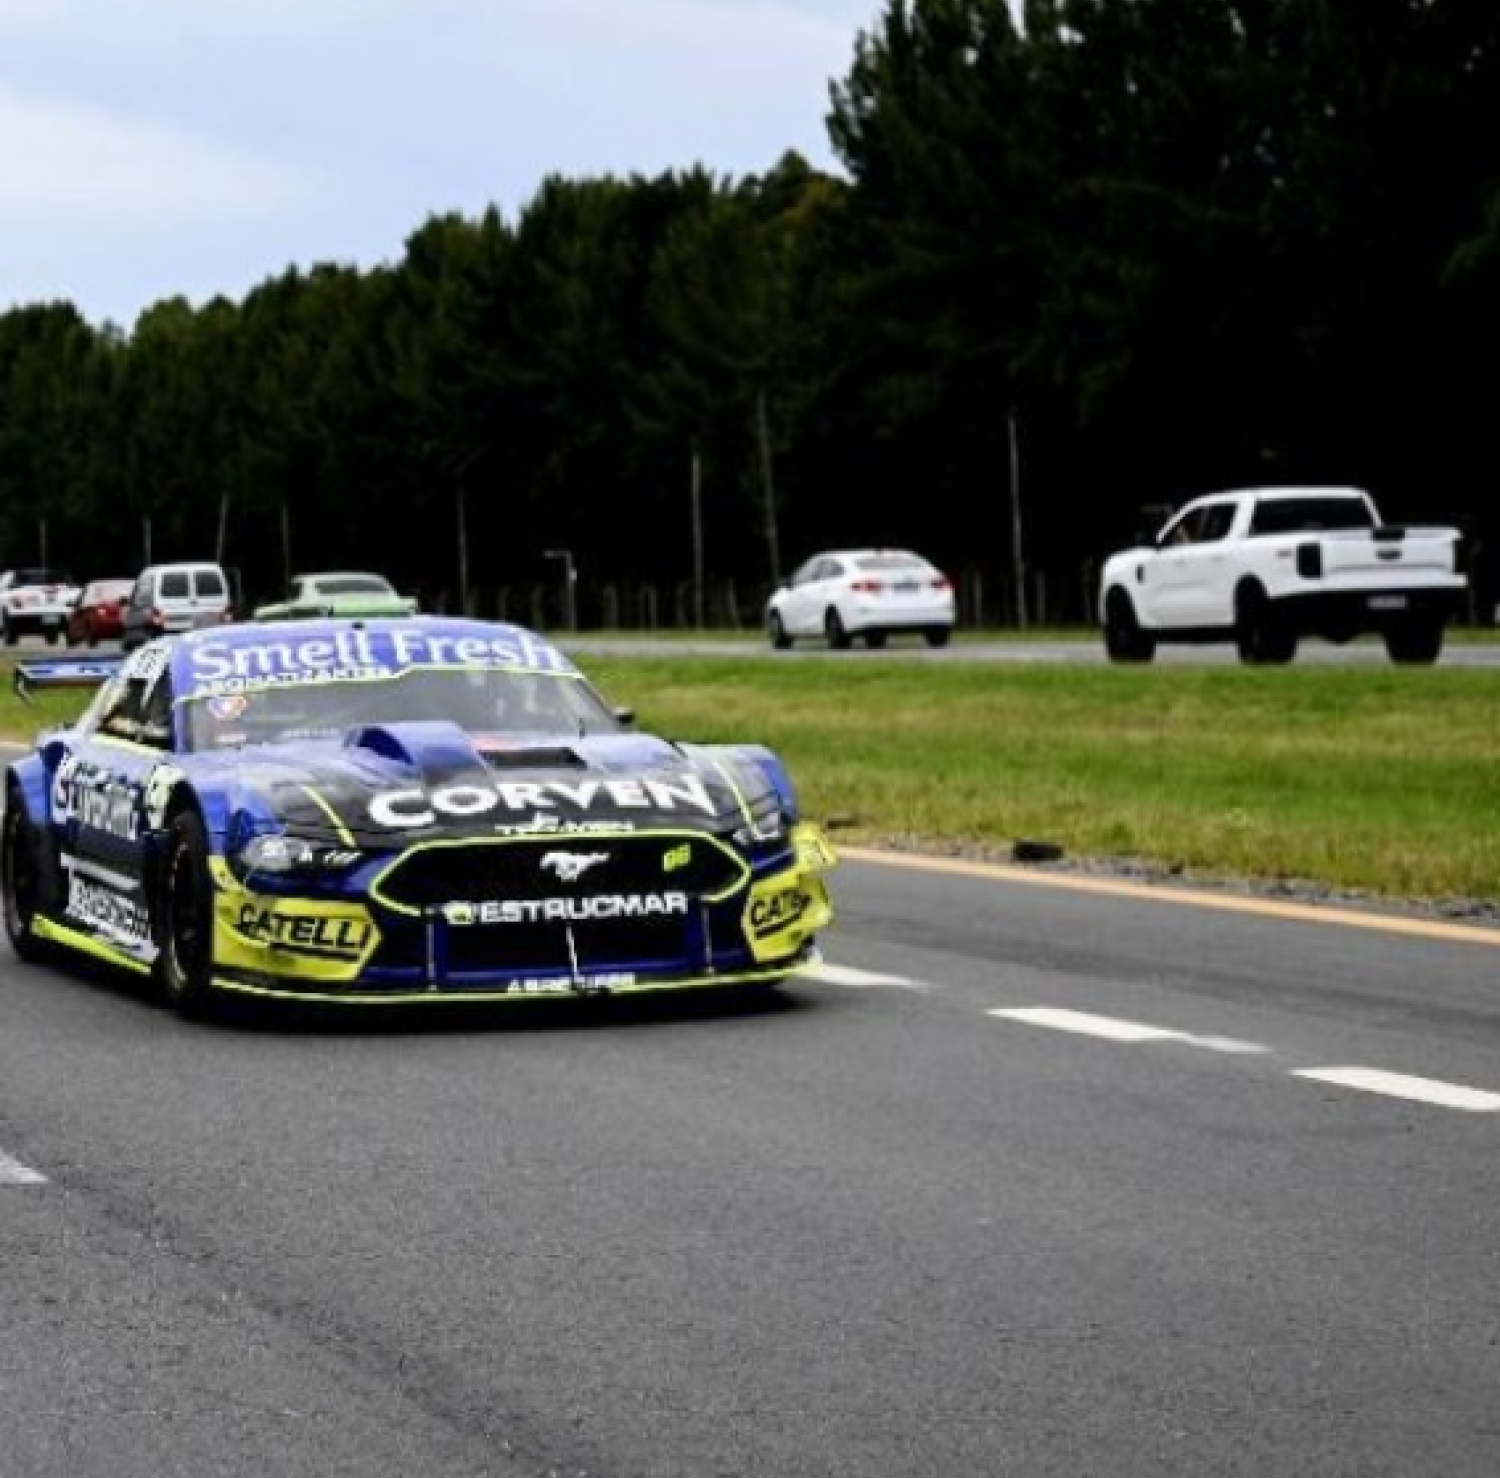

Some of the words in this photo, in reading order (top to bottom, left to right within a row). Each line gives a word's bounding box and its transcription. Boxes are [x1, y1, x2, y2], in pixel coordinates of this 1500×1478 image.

[191, 630, 373, 681] Smell
[390, 630, 564, 669] Fresh
[367, 773, 719, 827] CORVEN
[239, 901, 374, 947] CATELLI
[479, 892, 689, 923] ESTRUCMAR
